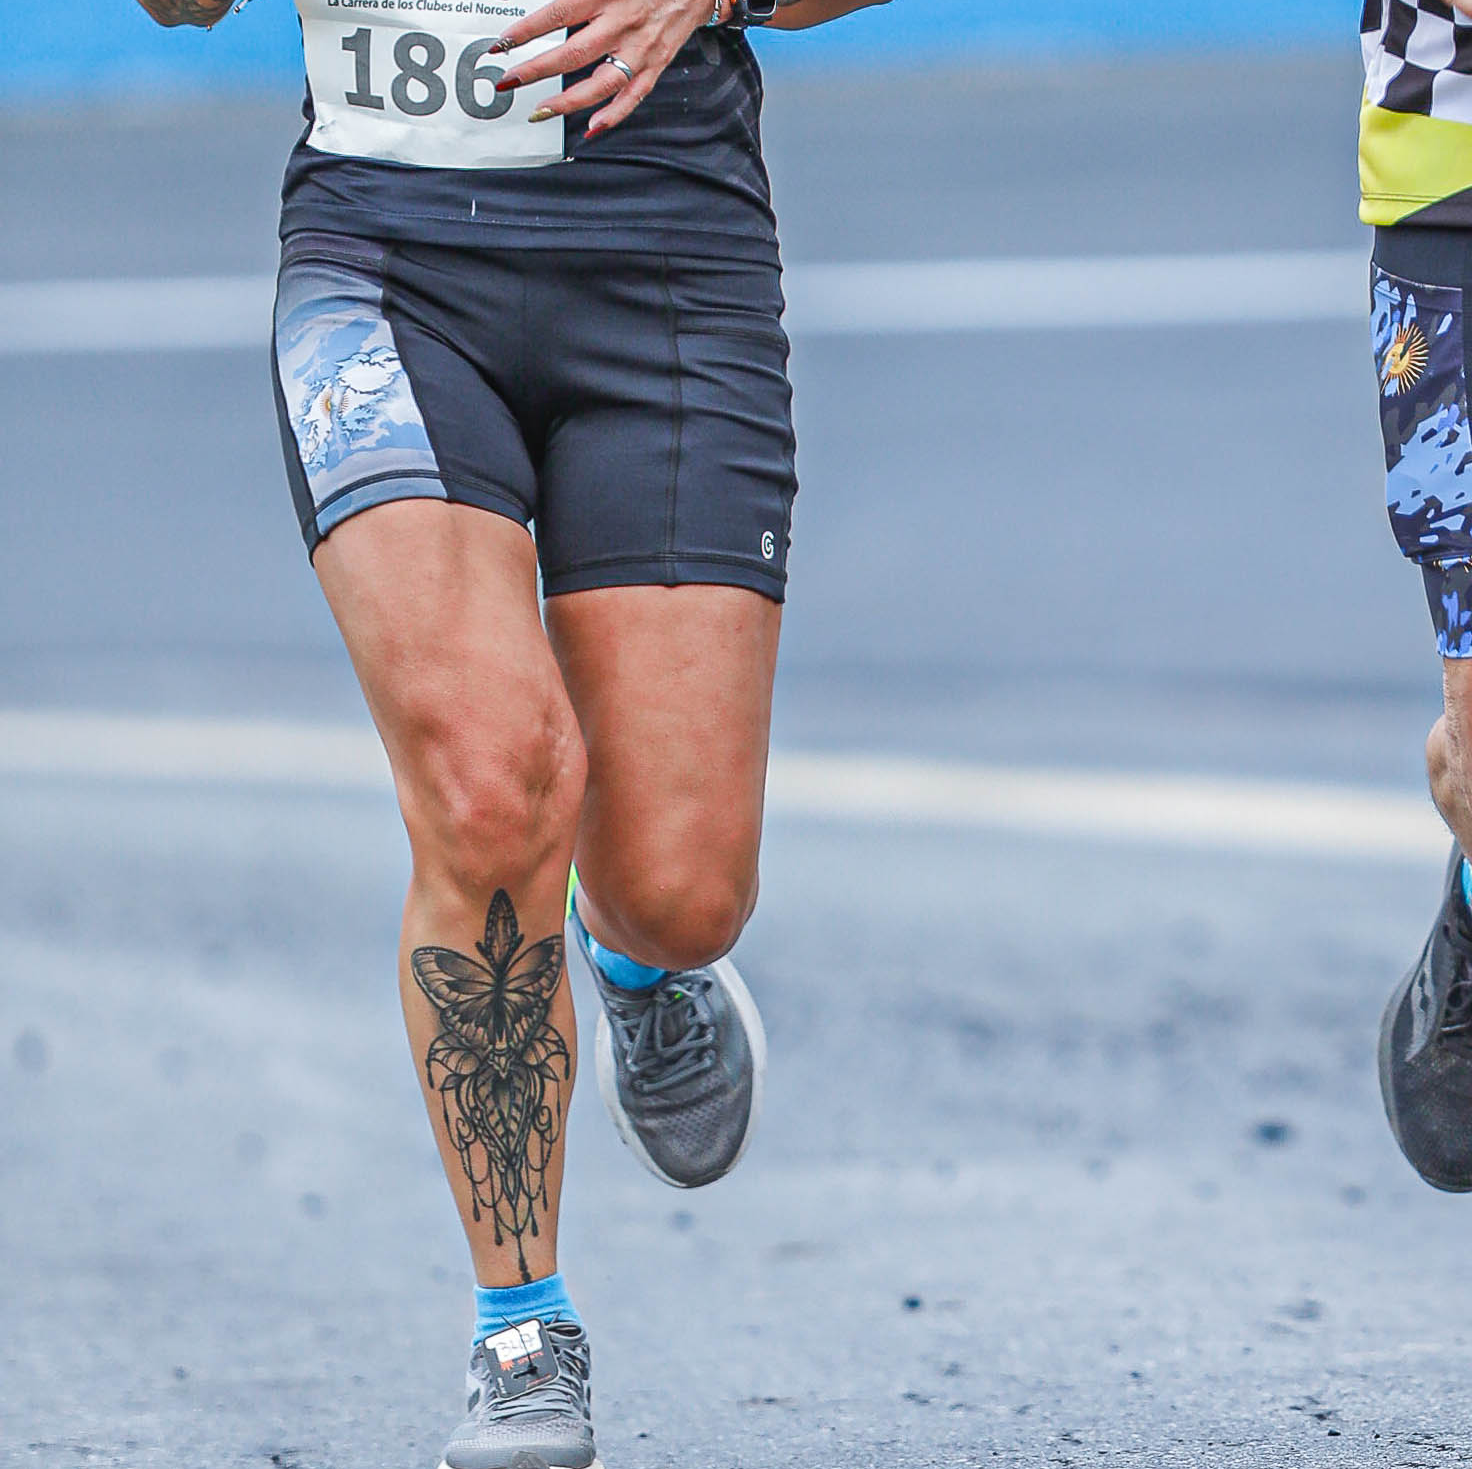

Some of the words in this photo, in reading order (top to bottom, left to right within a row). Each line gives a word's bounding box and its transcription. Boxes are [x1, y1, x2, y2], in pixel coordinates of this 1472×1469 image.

[416, 0, 452, 12] Clubes
[455, 1, 473, 13] del
[475, 3, 526, 17] Noroeste
[341, 27, 515, 121] 186
